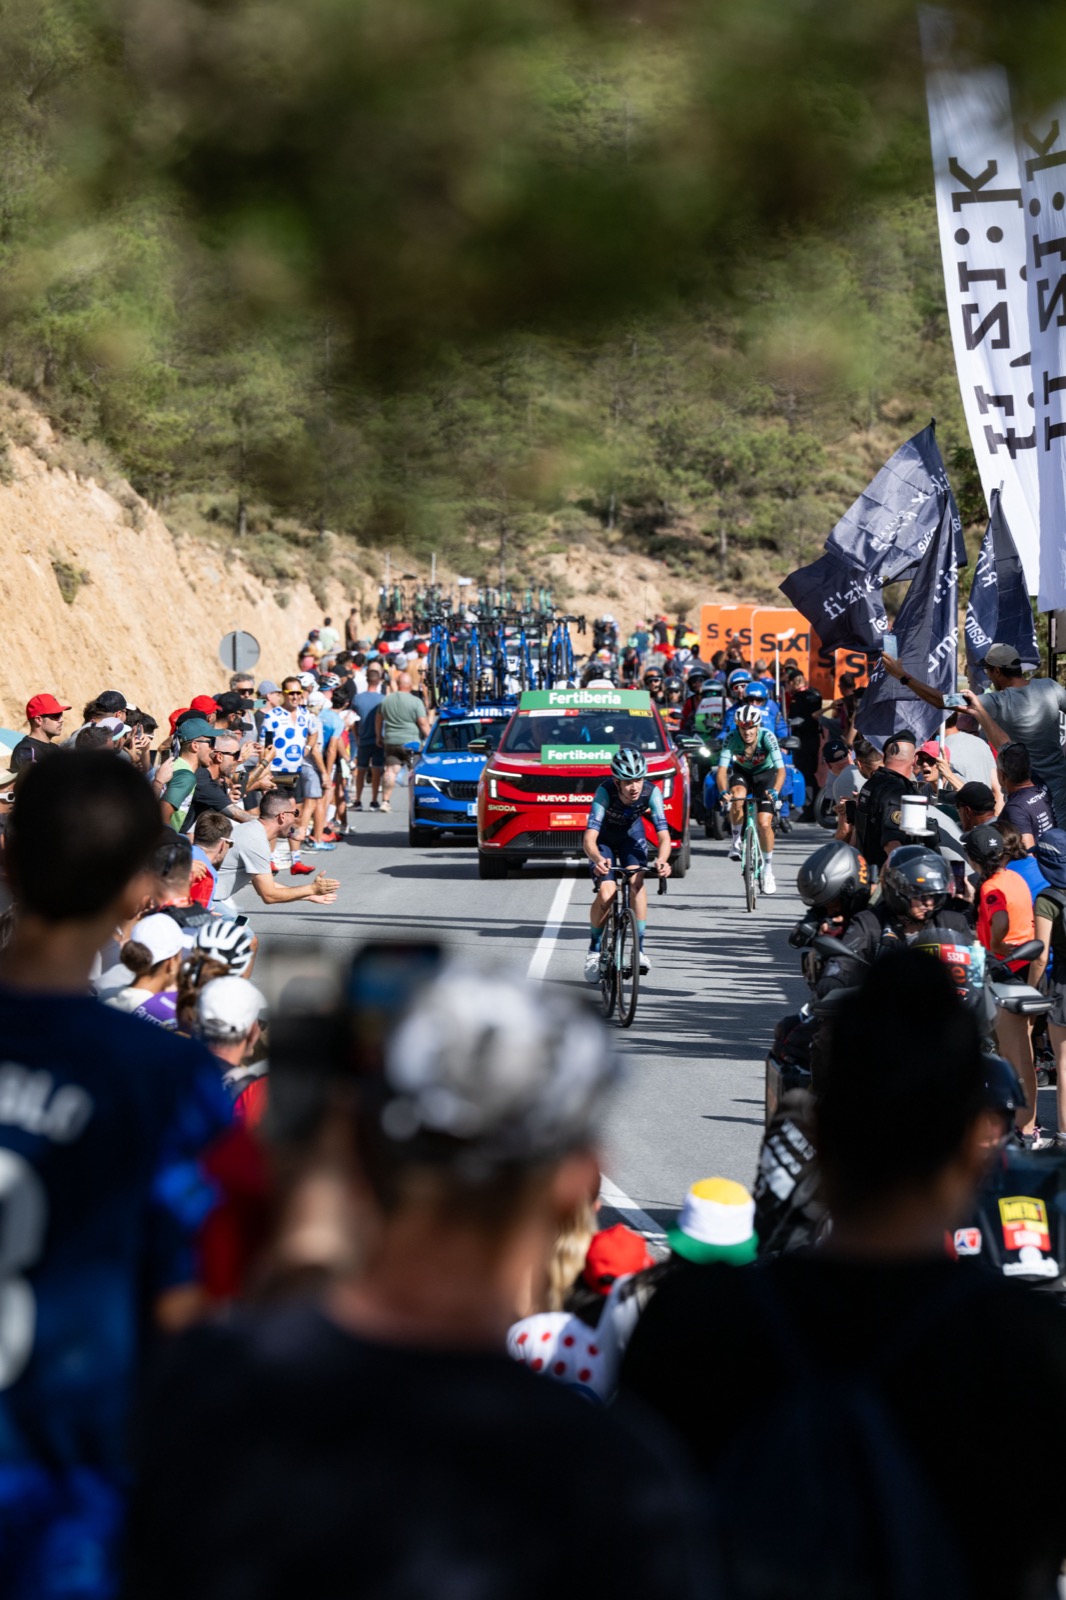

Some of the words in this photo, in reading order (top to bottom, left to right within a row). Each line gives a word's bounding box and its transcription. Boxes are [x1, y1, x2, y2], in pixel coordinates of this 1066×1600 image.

[549, 691, 621, 705] Fertiberia
[465, 708, 517, 717] SHIMA
[547, 750, 612, 761] Fertiberia
[537, 795, 567, 803] NUEVO
[568, 793, 594, 803] ŠKOD
